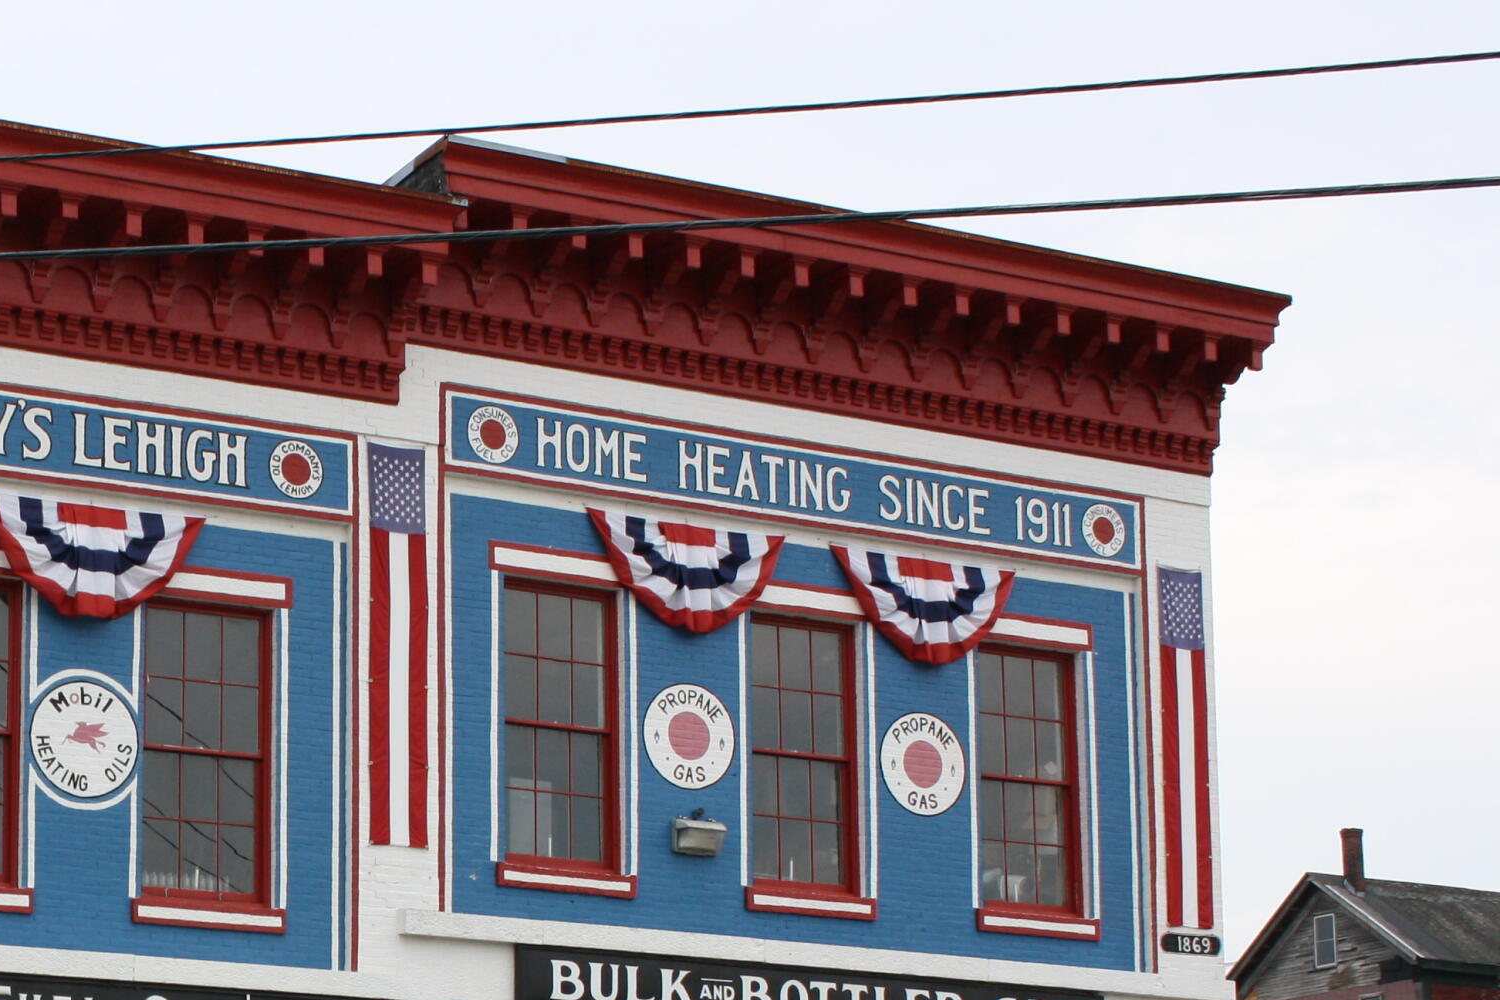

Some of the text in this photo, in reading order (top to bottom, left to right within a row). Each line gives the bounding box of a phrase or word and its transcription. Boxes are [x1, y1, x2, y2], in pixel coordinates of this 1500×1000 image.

[470, 408, 516, 439] CONSUMERS
[73, 412, 249, 489] LEHIGH
[472, 437, 496, 460] FUEL
[272, 454, 281, 476] OLD
[280, 481, 313, 496] LEHIGH
[536, 416, 1074, 548] HOME HEATING SINCE 1911
[1086, 533, 1106, 555] FUEL
[49, 686, 114, 713] Mobil
[657, 689, 724, 724] PROPANE
[891, 717, 955, 751] PROPANE
[36, 735, 133, 791] HEATING OILS
[673, 764, 706, 784] GAS
[907, 791, 938, 810] GAS
[1177, 936, 1210, 953] 1869
